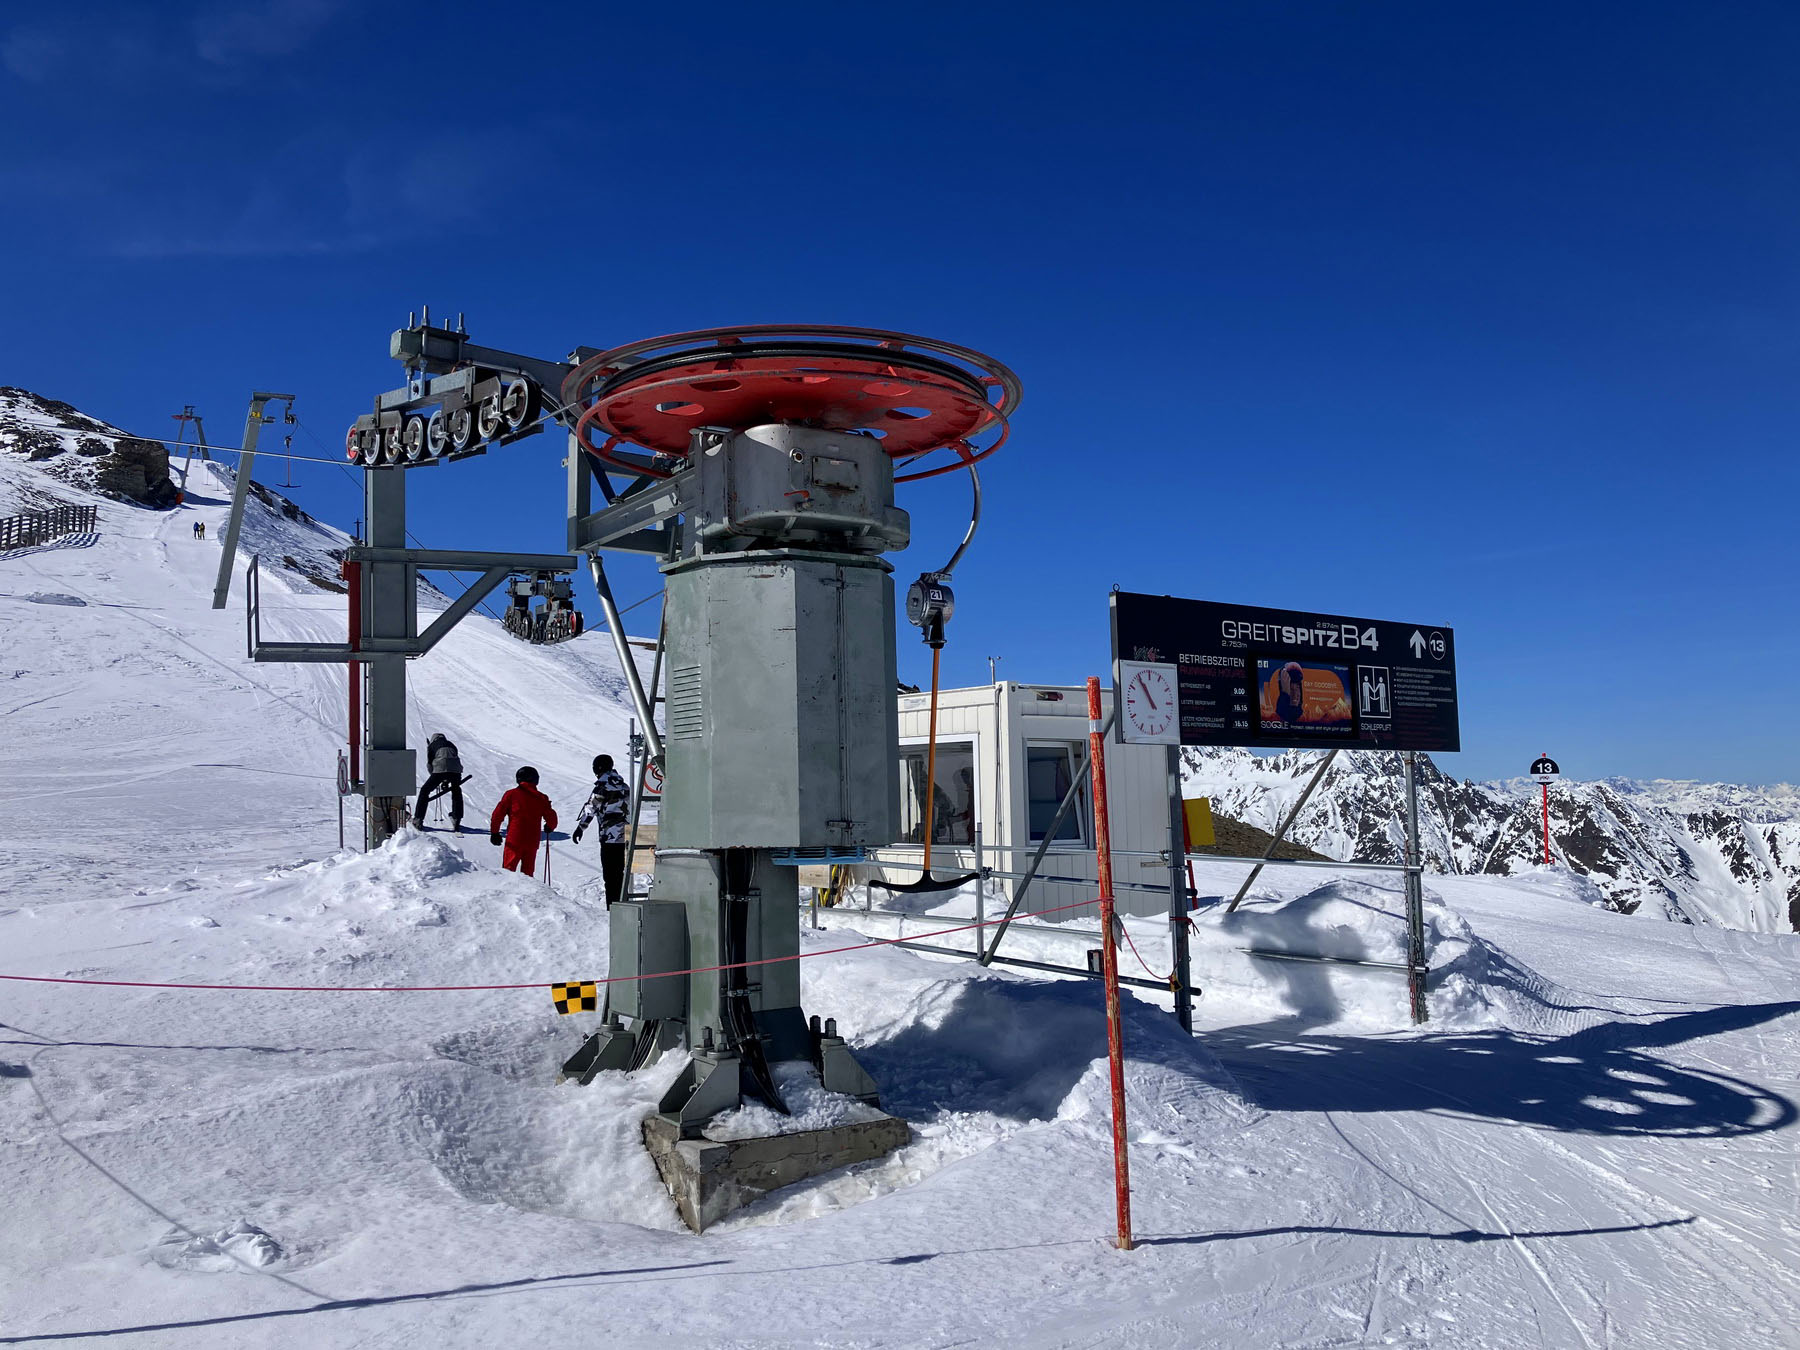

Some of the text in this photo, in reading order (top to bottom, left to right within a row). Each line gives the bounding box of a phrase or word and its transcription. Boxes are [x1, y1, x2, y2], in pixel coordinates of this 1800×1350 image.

[931, 591, 941, 599] 21
[1221, 620, 1379, 652] GREITSPITZ B4
[1221, 640, 1248, 648] 2.753m
[1430, 639, 1445, 652] 13
[1179, 653, 1245, 668] BETRIEBSZEITEN
[1233, 687, 1245, 695] 9.00
[1260, 720, 1289, 730] SOGGLE
[1360, 722, 1392, 731] SCHLEPPLIFT
[1537, 763, 1552, 773] 13
